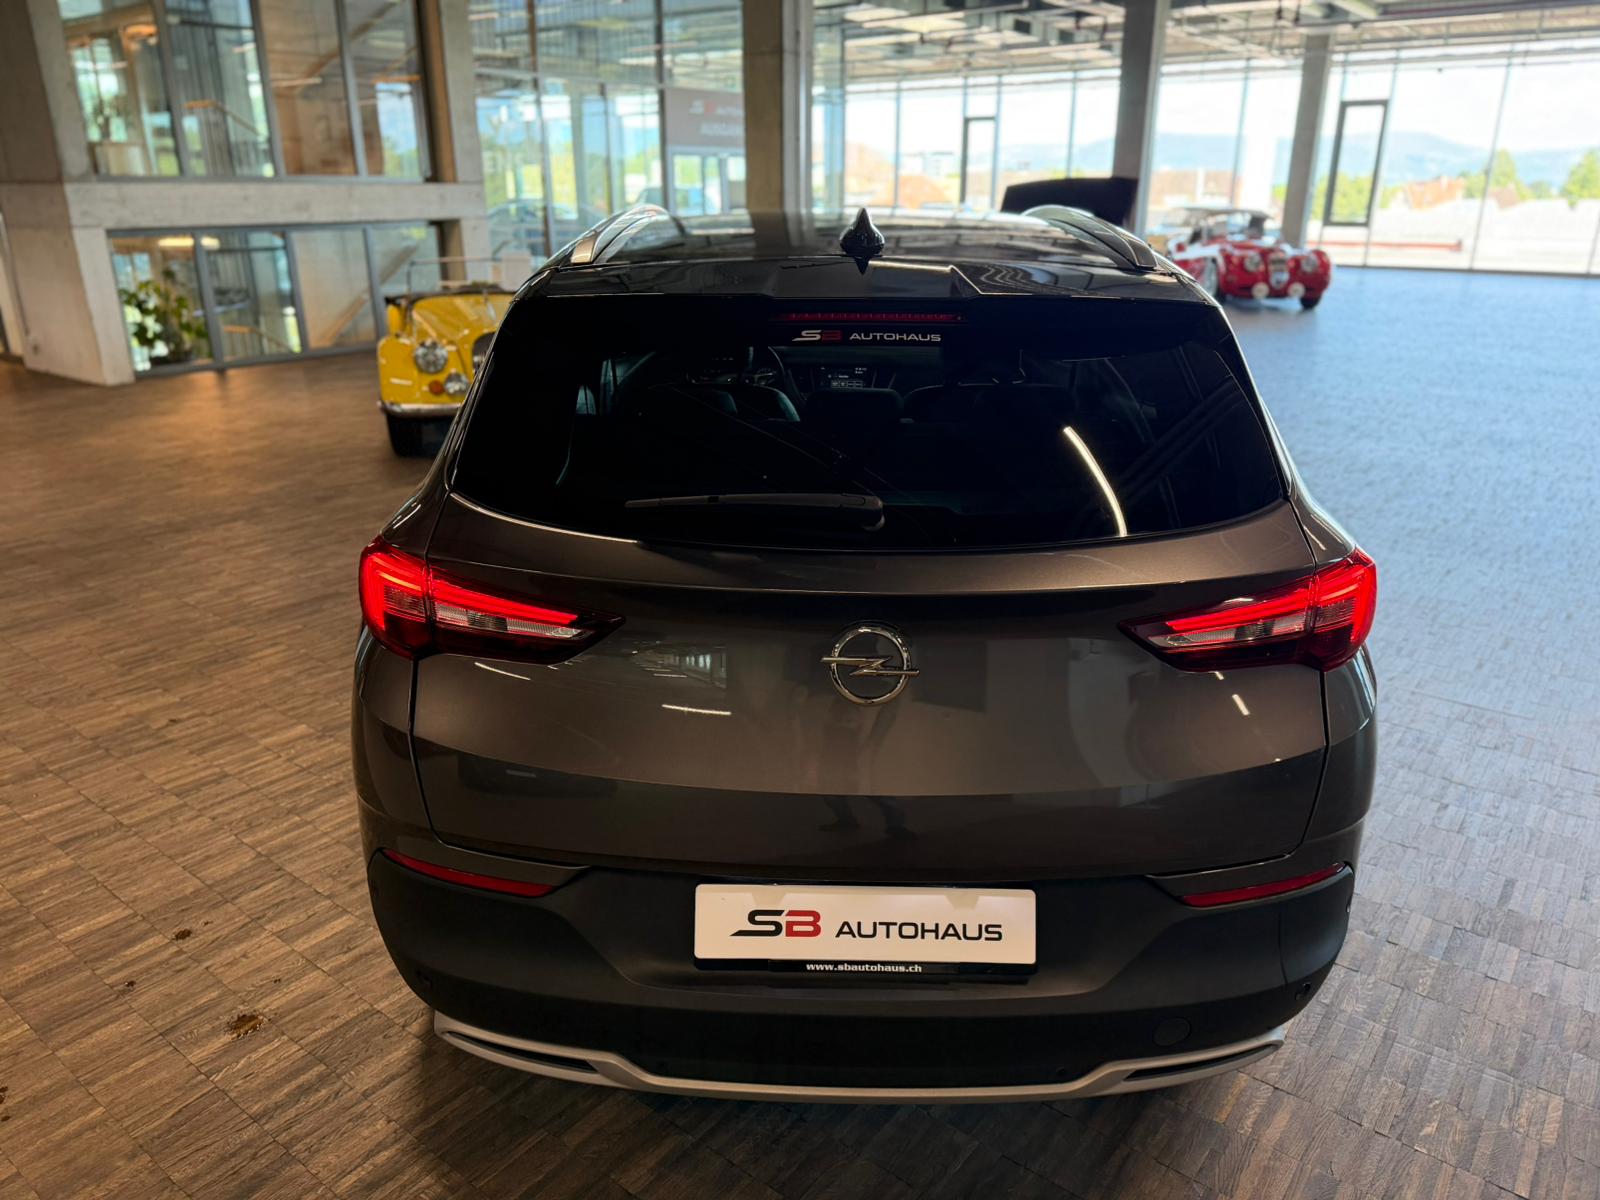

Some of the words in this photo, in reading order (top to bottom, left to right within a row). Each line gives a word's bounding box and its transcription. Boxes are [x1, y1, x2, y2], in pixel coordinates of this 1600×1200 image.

[791, 329, 842, 342] SB
[849, 332, 942, 342] AUTOHAUS
[729, 909, 822, 938] SB
[835, 920, 1003, 942] AUTOHAUS
[805, 962, 922, 974] www.sbautohaus.ch
